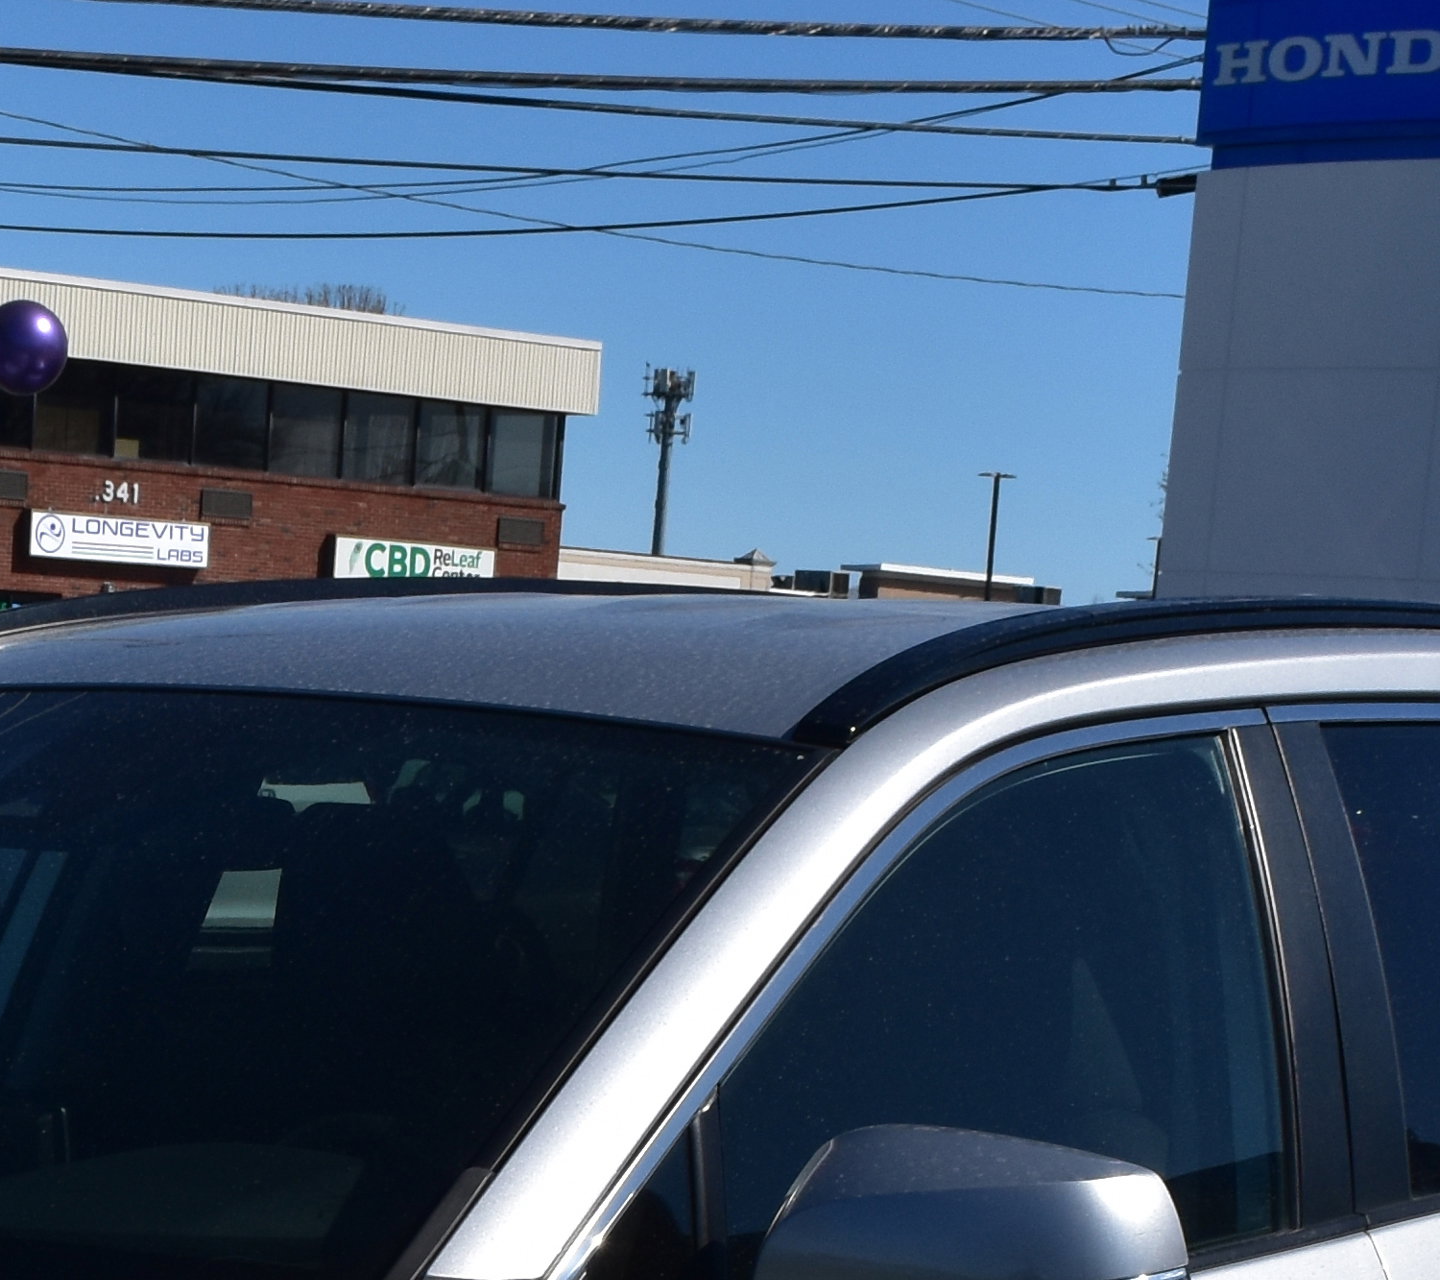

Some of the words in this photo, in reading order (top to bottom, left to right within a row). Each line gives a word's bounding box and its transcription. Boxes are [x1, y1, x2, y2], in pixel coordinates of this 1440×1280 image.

[72, 517, 204, 542] LONGEVITY
[156, 548, 204, 563] LABS
[365, 543, 431, 577] CBD
[434, 548, 482, 568] ReLeaf
